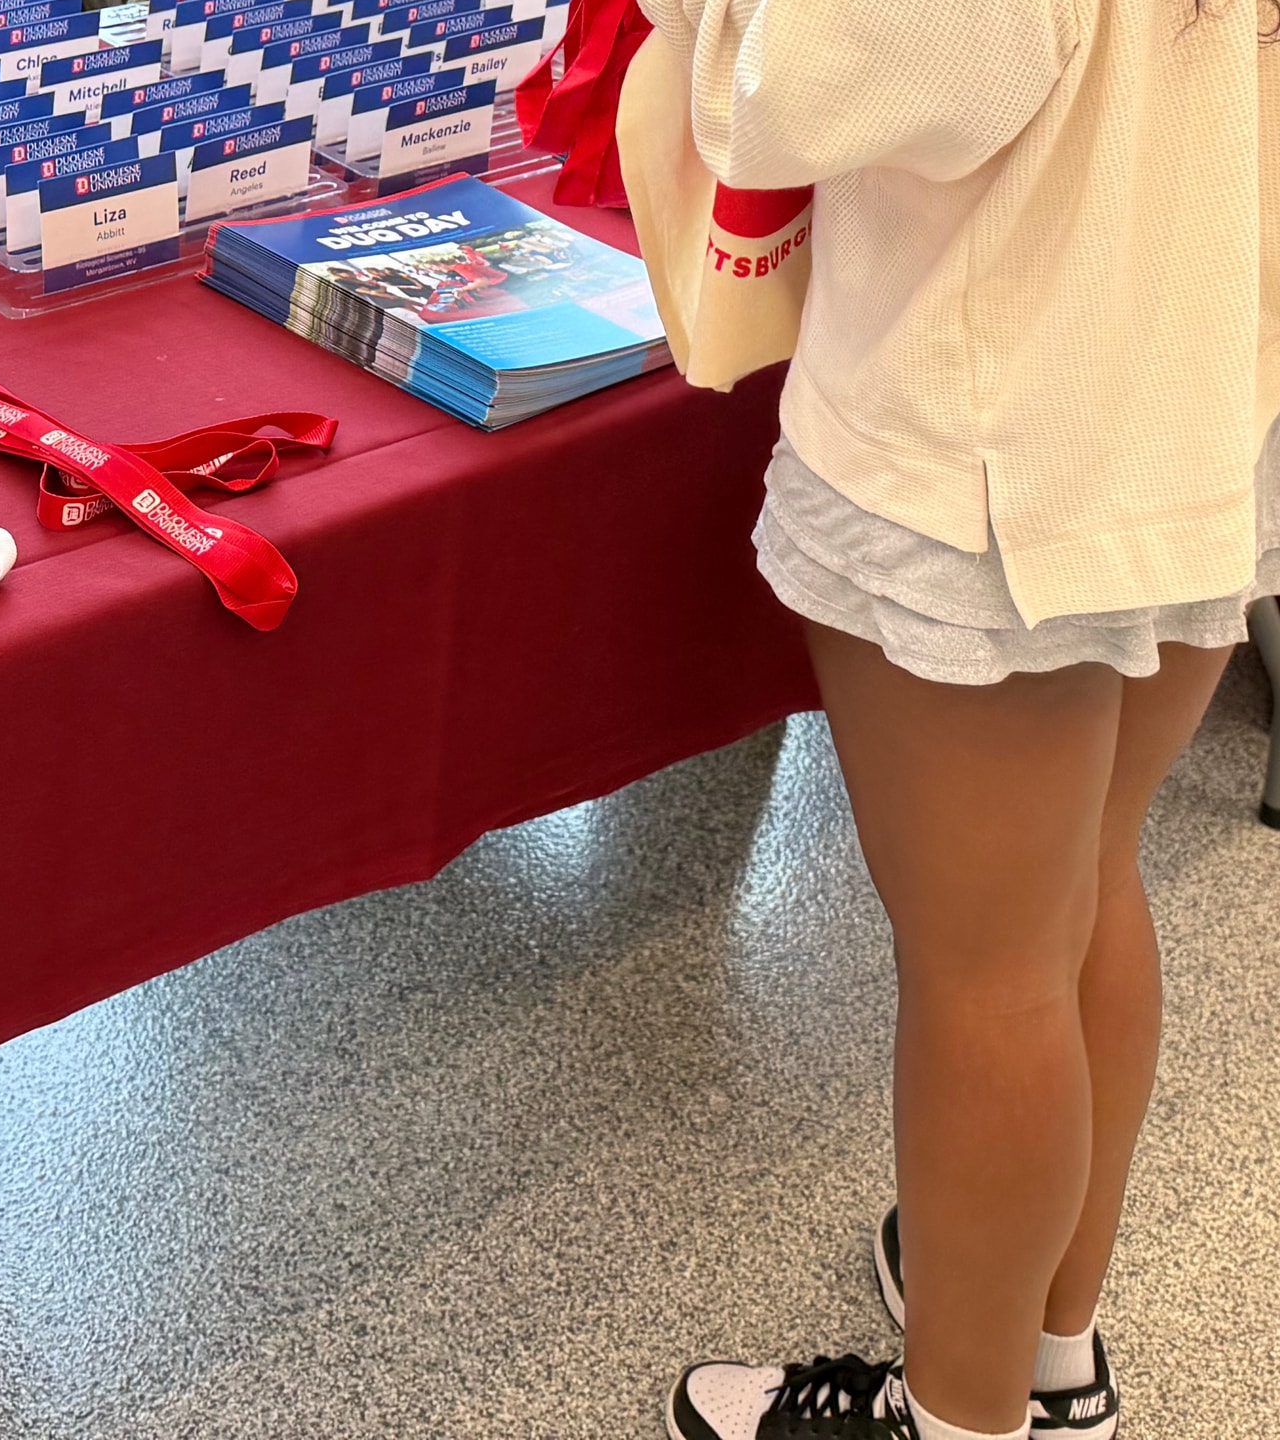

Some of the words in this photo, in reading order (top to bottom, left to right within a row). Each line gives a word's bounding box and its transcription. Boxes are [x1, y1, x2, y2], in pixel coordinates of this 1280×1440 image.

[24, 20, 68, 35] DUQUESNE
[85, 47, 130, 63] DUQUESNE
[471, 57, 508, 74] Bailey
[69, 79, 127, 102] Mitchell
[146, 78, 191, 95] DUQUESNE
[174, 93, 219, 111] DUQUESNE
[0, 122, 49, 138] DUQUESNE
[205, 112, 251, 128] DUQUESNE
[27, 133, 77, 152] DUQUESNE
[237, 127, 281, 145] DUQUESNE
[401, 120, 471, 148] Mackenzie
[27, 141, 76, 160] UNIVERSITY
[56, 147, 104, 167] DUQUESNE
[56, 155, 103, 175] UNIVERSITY
[90, 163, 141, 183] DUQUESNE
[230, 162, 266, 183] Reed
[90, 172, 140, 192] UNIVERSITY
[230, 181, 264, 196] Angeles
[94, 208, 127, 226] Liza
[328, 217, 408, 235] WELCOME
[407, 211, 430, 222] TO
[97, 227, 125, 241] Abbitt
[316, 229, 404, 250] DUQ
[395, 210, 471, 237] DAY
[51, 440, 105, 471] UNIVERSITY
[61, 434, 111, 462] DUQUESNE
[148, 510, 209, 556] UNIVERSITY
[156, 500, 218, 551] DUQUESNE
[891, 1377, 905, 1411] NIKE
[1068, 1390, 1108, 1420] NIKE
